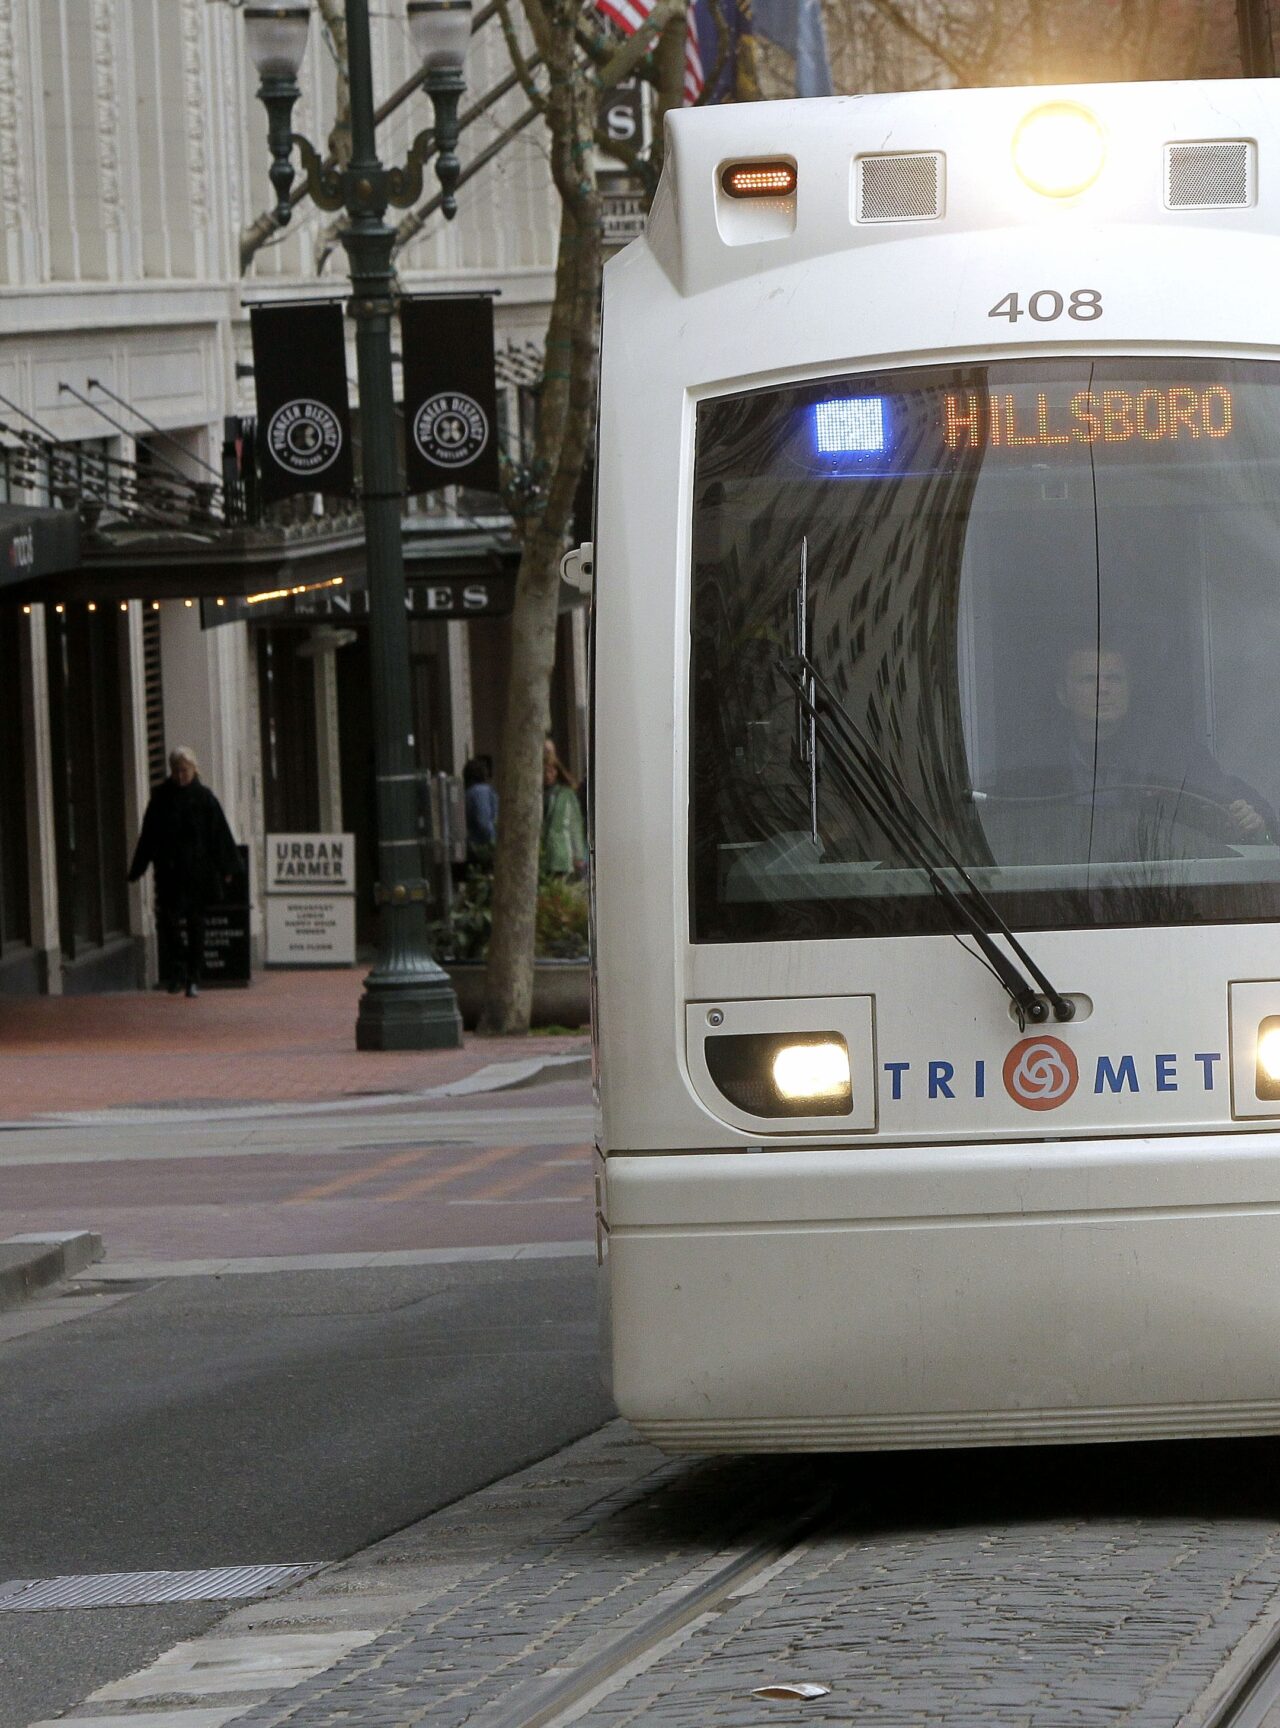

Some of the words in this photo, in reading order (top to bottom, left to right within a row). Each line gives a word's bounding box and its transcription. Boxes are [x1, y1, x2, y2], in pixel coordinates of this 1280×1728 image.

[988, 289, 1103, 323] 408
[946, 386, 1232, 447] HILLSBORO
[277, 842, 343, 859] URBAN
[277, 862, 343, 876] FARMER
[884, 1060, 985, 1100] TRI
[1093, 1053, 1222, 1094] MET
